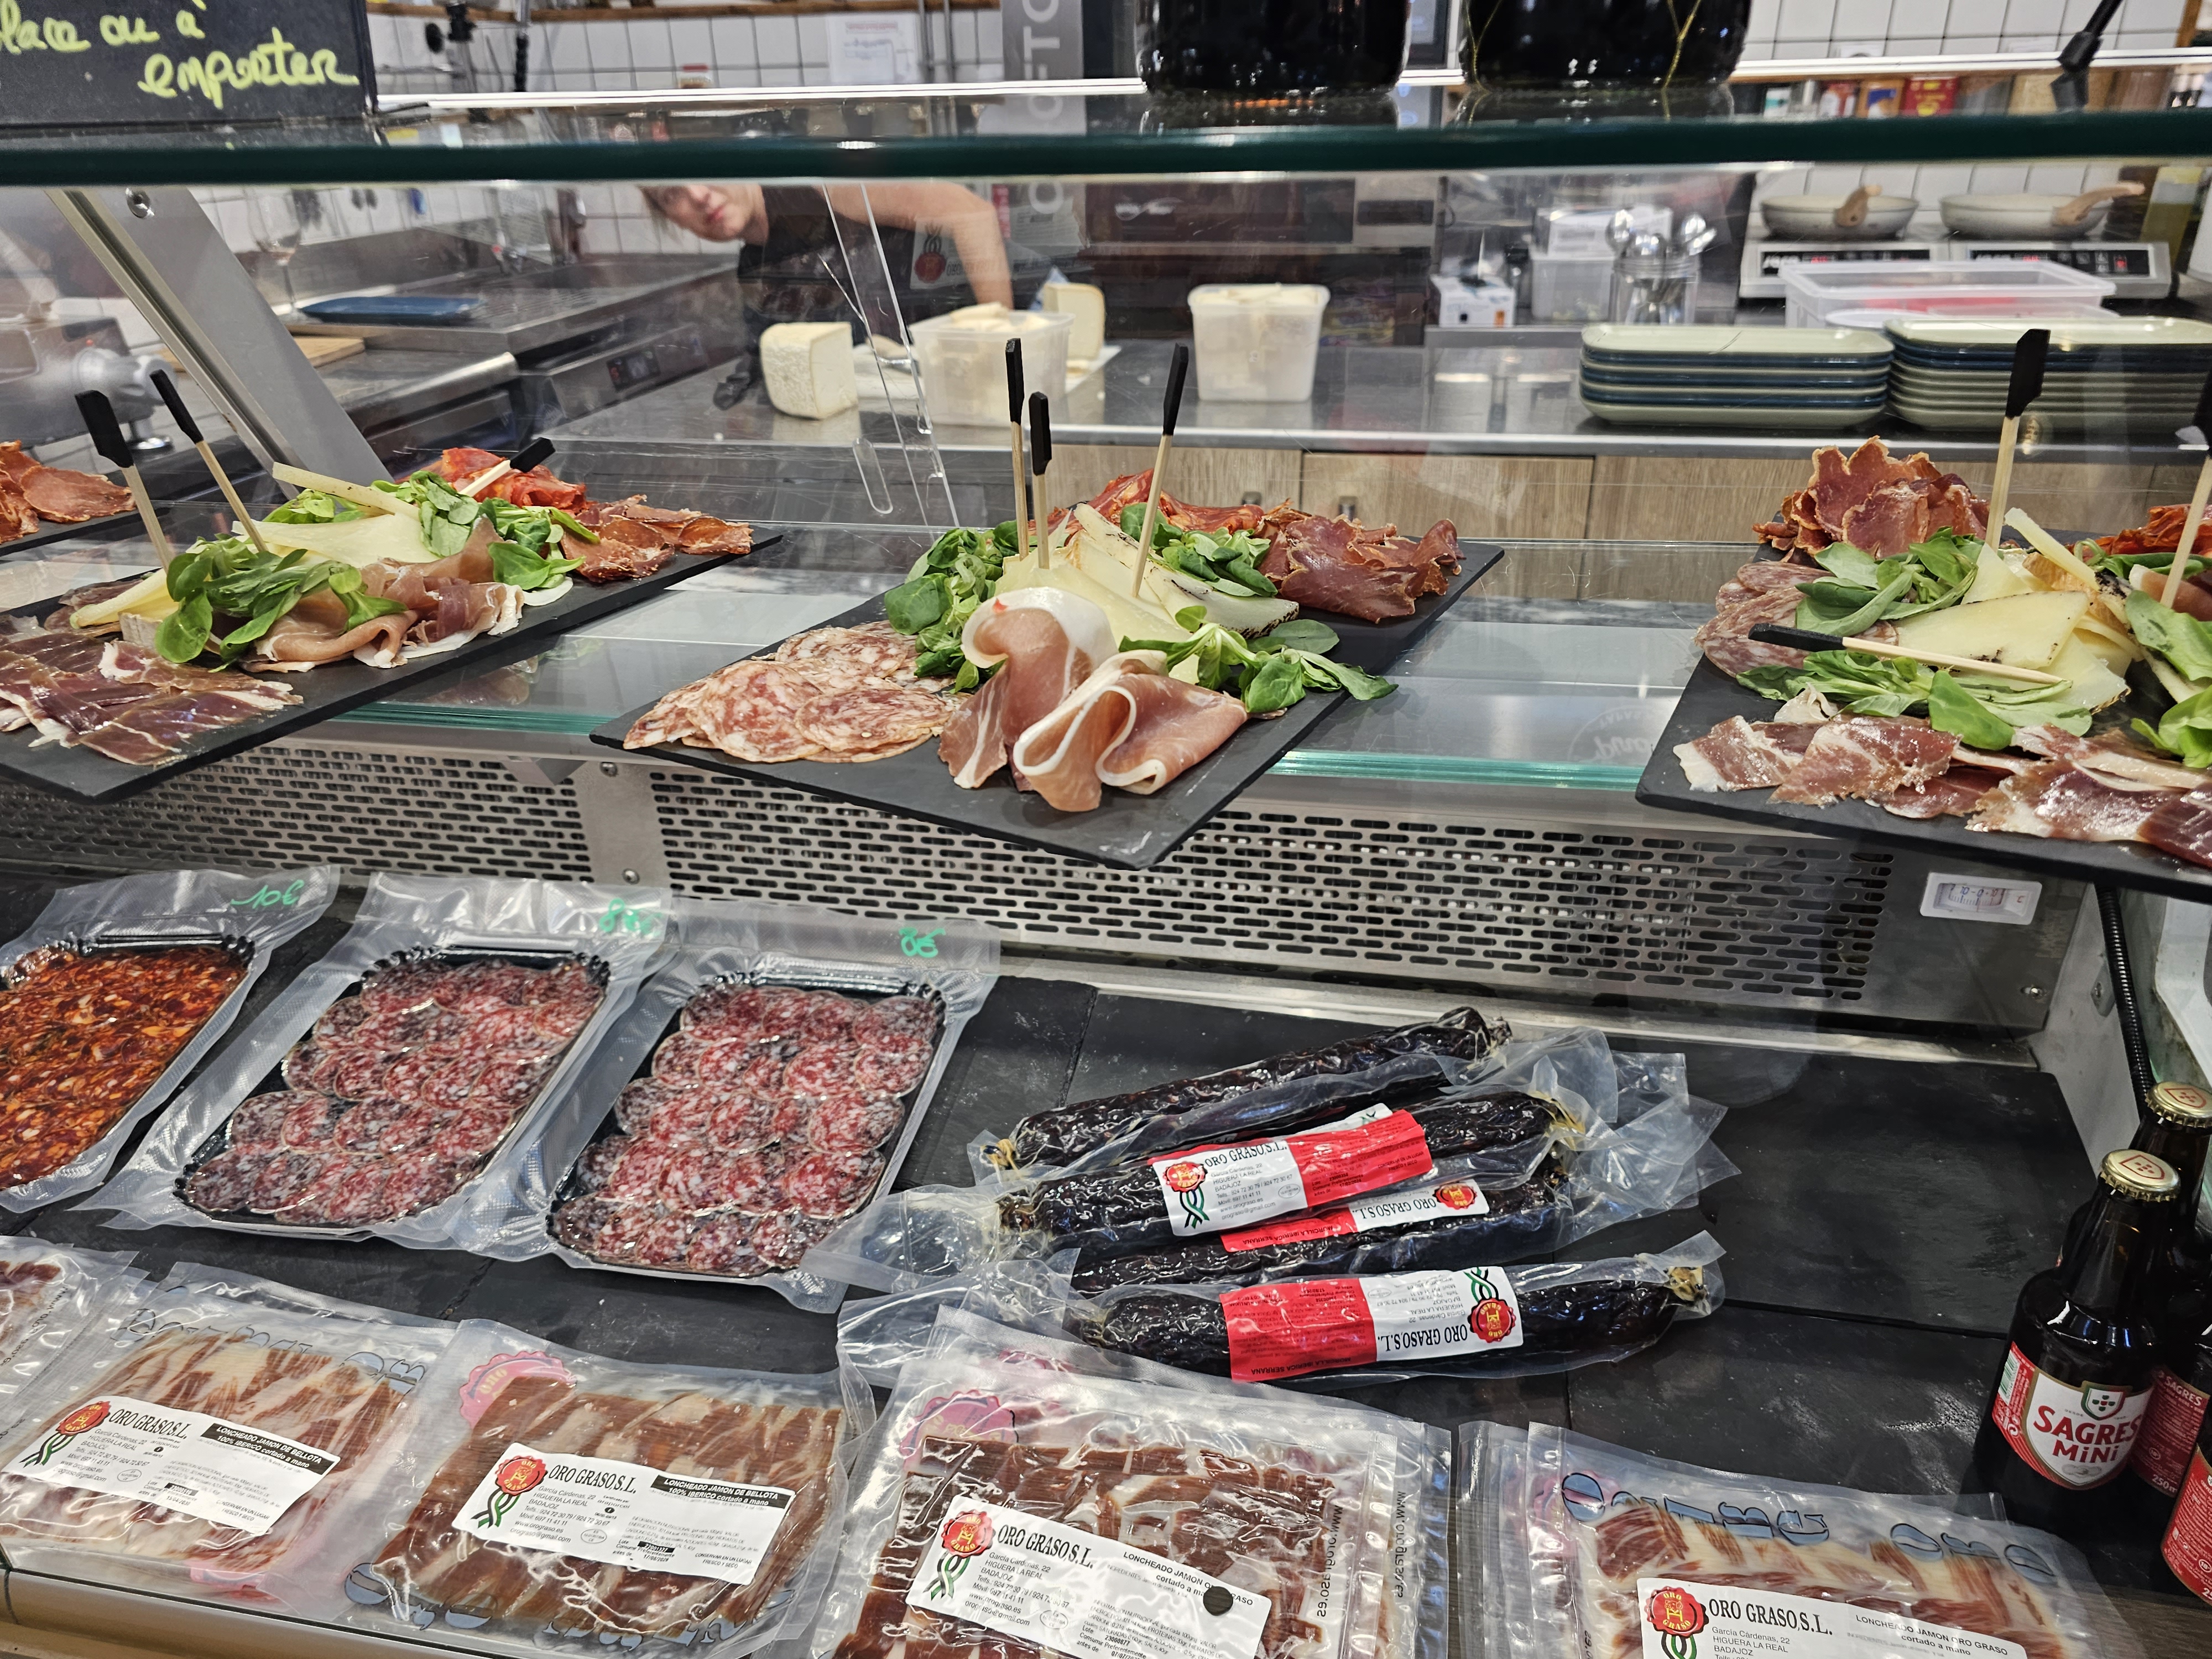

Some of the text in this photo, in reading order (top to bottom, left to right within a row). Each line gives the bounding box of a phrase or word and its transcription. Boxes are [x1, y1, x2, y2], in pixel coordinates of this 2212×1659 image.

[1204, 1154, 1228, 1167] ORO
[1213, 1174, 1238, 1185] HIGUERA
[1215, 1181, 1241, 1192] BADAJOZ
[1411, 1197, 1436, 1209] ORO
[1444, 1324, 1467, 1343] ORO
[1251, 1366, 1285, 1375] SERRANA
[1286, 1361, 1313, 1370] IBERICA
[2165, 1376, 2202, 1406] SAGRES
[108, 1409, 137, 1427] ORO
[2033, 1405, 2143, 1445] SAGRES
[216, 1426, 257, 1443] LONCHEADO
[257, 1437, 280, 1449] JAMON
[280, 1444, 290, 1453] DE
[290, 1447, 321, 1464] BELLOTA
[217, 1435, 234, 1444] 100%
[261, 1447, 285, 1459] cortado
[291, 1459, 310, 1468] mano
[549, 1465, 576, 1482] ORO
[504, 1479, 528, 1490] GRASO
[2152, 1474, 2169, 1489] 250
[664, 1479, 708, 1491] LONCHEADO
[745, 1490, 778, 1499] BELLOTA
[529, 1499, 560, 1509] BADAJOZ
[534, 1493, 563, 1502] HIGUERA
[966, 1515, 981, 1524] ORO
[515, 1520, 564, 1533] www.orograso.es
[510, 1527, 571, 1543] orograso@gmail.com
[998, 1525, 1026, 1547] ORO
[950, 1539, 975, 1552] GRASO
[989, 1552, 1009, 1562] García
[980, 1568, 1014, 1582] BADAJOZ
[985, 1559, 1015, 1573] HIGUERA
[1025, 1569, 1043, 1579] REAL
[1123, 1551, 1172, 1574] LONCHEADO
[1174, 1569, 1203, 1586] JAMON
[1156, 1574, 1185, 1589] cortado
[1663, 1592, 1681, 1600] ORO
[1708, 1599, 1741, 1619] ORO
[1082, 1625, 1094, 1634] Lote
[1662, 1620, 1691, 1630] GRASO
[1105, 1635, 1130, 1646] 23000877
[1712, 1627, 1737, 1636] García
[1739, 1631, 1778, 1642] Cárdenas,
[1901, 1635, 1935, 1647] cortado
[1077, 1640, 1091, 1651] antes
[1079, 1632, 1146, 1658] Consumir Preferentemente
[1713, 1636, 1751, 1647] HIGUERA
[1766, 1644, 1788, 1652] REAL
[1916, 1628, 1949, 1642] JAMON
[1951, 1636, 1972, 1646] ORO
[1974, 1641, 2007, 1656] GRASO
[1714, 1645, 1754, 1656] BADAJOZ
